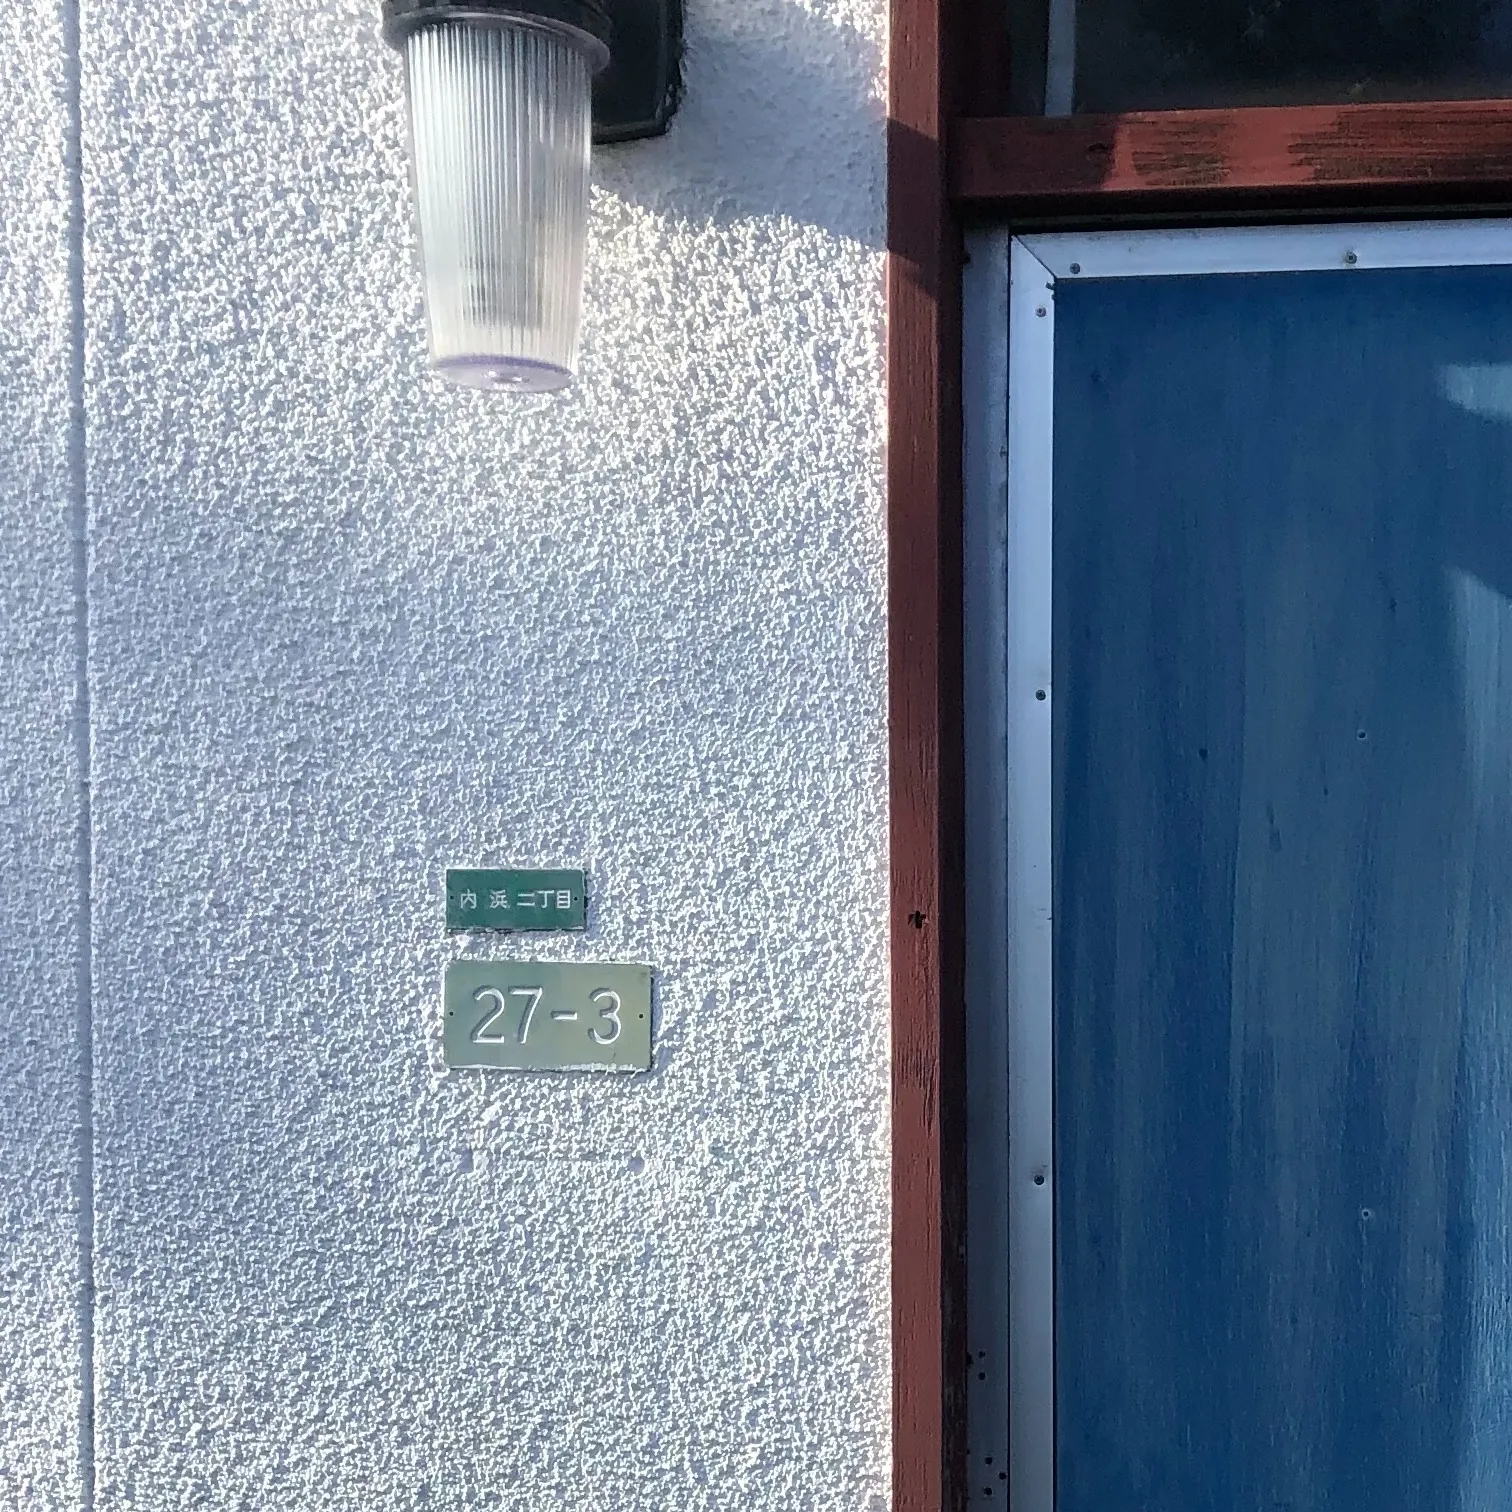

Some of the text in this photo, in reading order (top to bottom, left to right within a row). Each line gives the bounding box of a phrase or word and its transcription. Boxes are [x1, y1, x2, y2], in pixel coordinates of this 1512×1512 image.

[460, 888, 571, 909] 内浜二丁目
[470, 984, 622, 1045] 27-3
